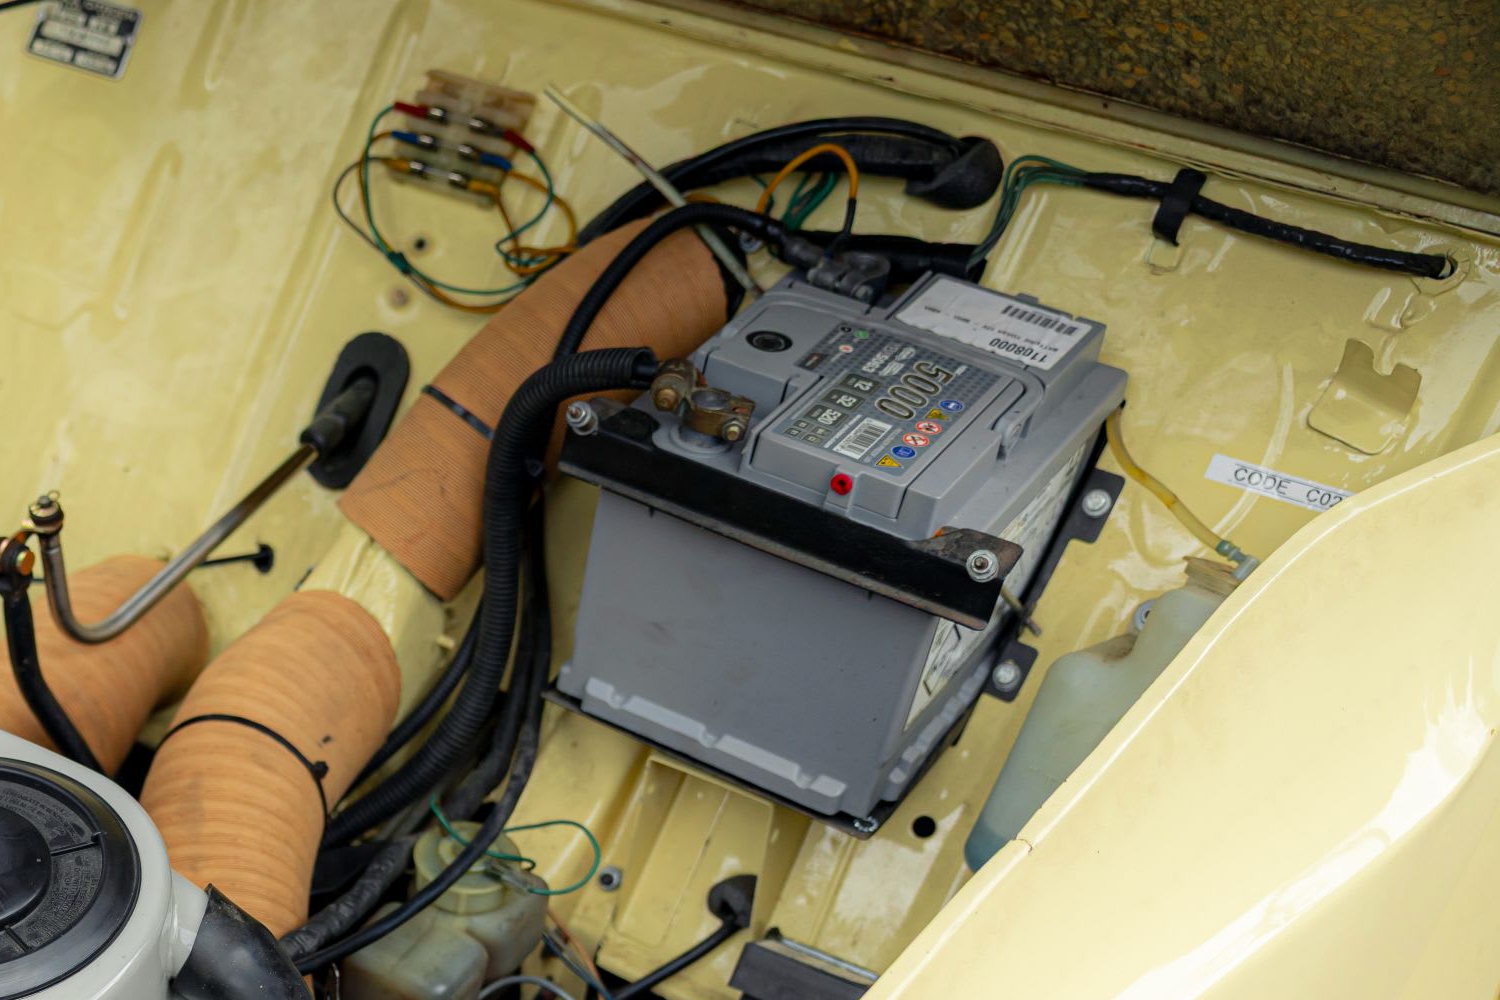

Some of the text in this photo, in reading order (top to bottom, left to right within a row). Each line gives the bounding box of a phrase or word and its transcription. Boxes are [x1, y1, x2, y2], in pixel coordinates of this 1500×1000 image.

[989, 337, 1048, 363] 1108000
[853, 380, 874, 391] 12
[875, 361, 956, 420] 5000
[836, 395, 858, 408] 52
[817, 408, 843, 425] 520
[1234, 466, 1292, 496] CODE
